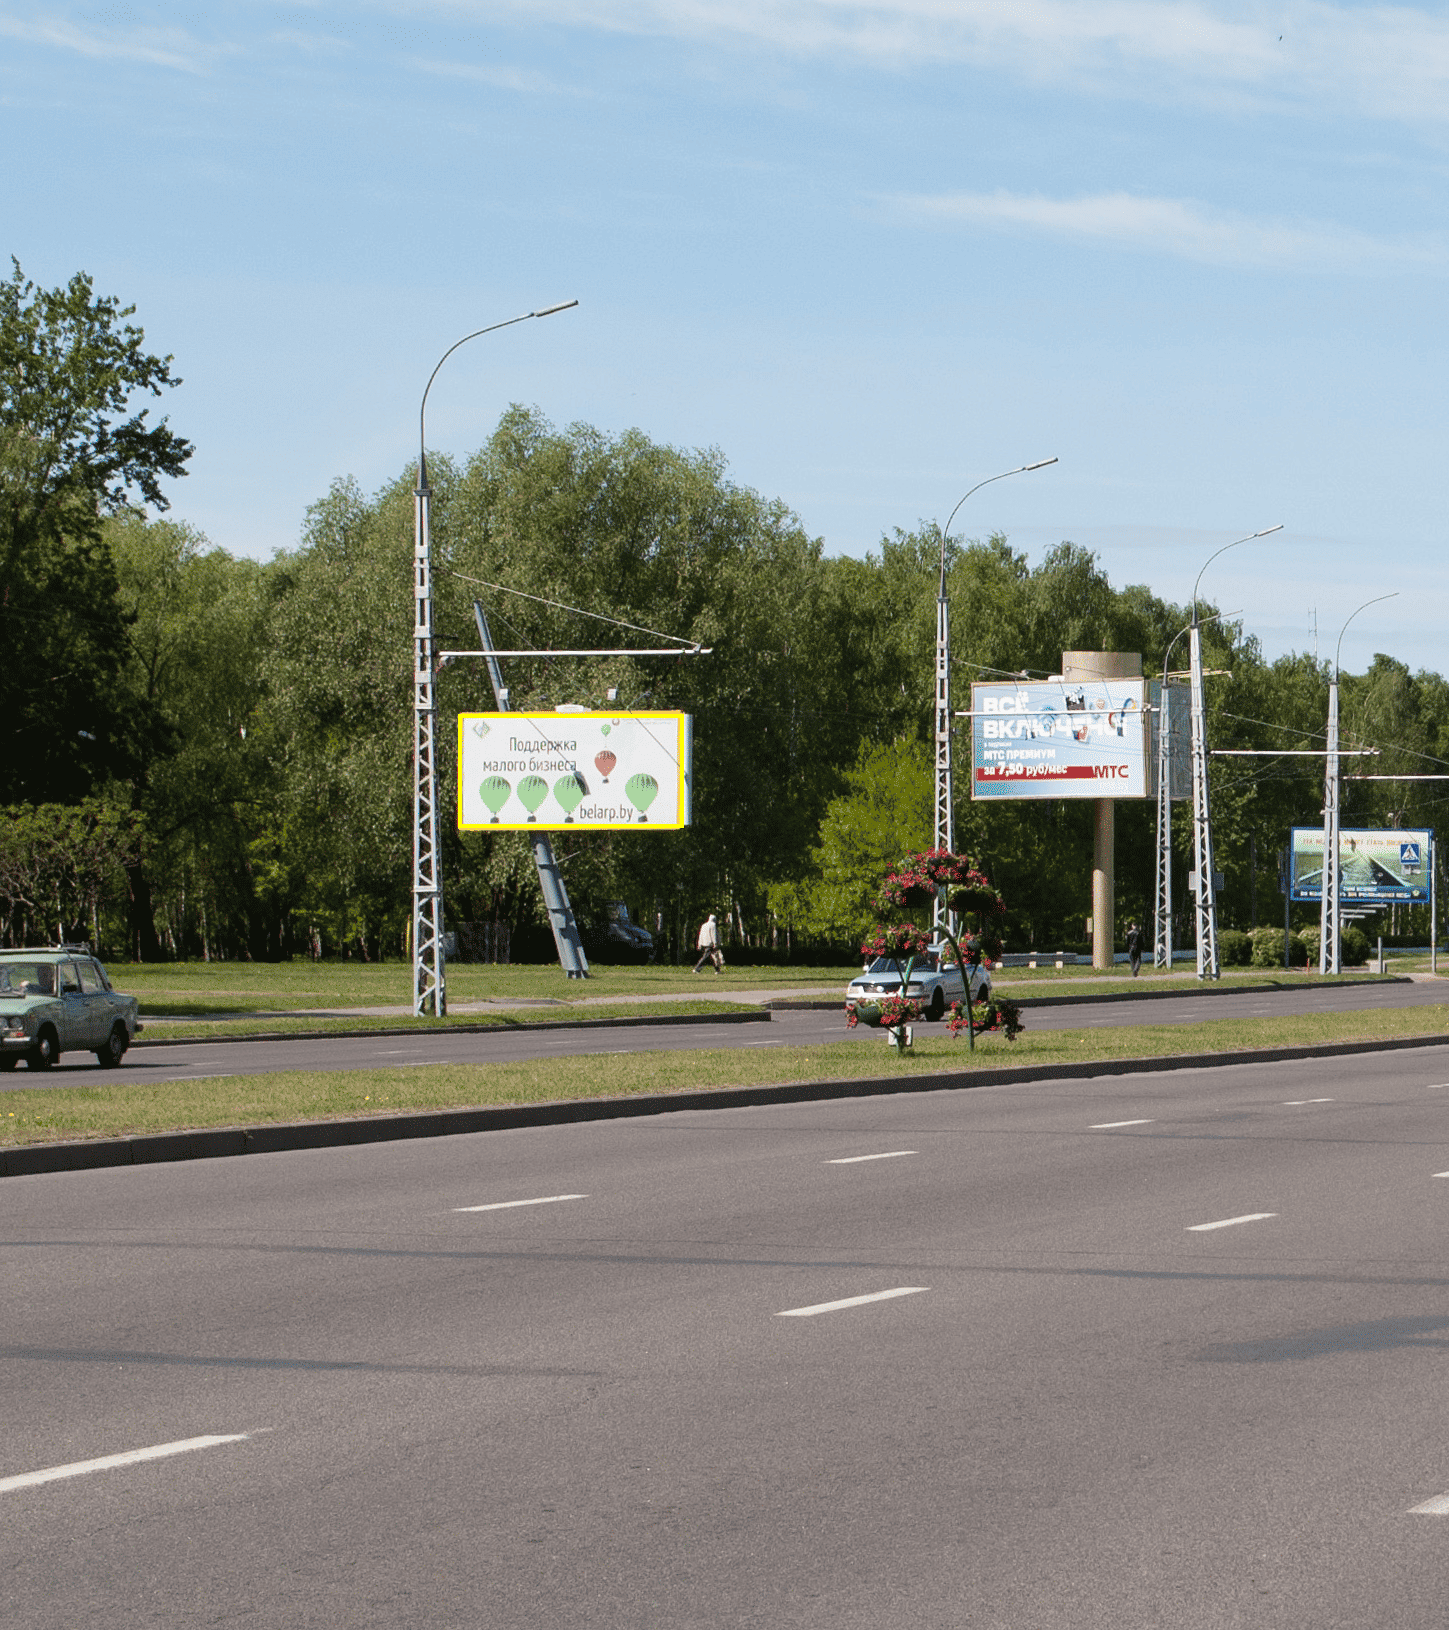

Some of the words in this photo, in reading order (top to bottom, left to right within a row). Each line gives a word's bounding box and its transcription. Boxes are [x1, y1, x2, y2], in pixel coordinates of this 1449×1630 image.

[509, 737, 577, 754] Поддержка
[983, 750, 1005, 760] МТС
[483, 760, 526, 772] малого
[529, 758, 577, 772] бизнеса
[998, 762, 1024, 776] 7,50
[1095, 765, 1129, 779] МТС
[580, 804, 633, 822] belarp.by
